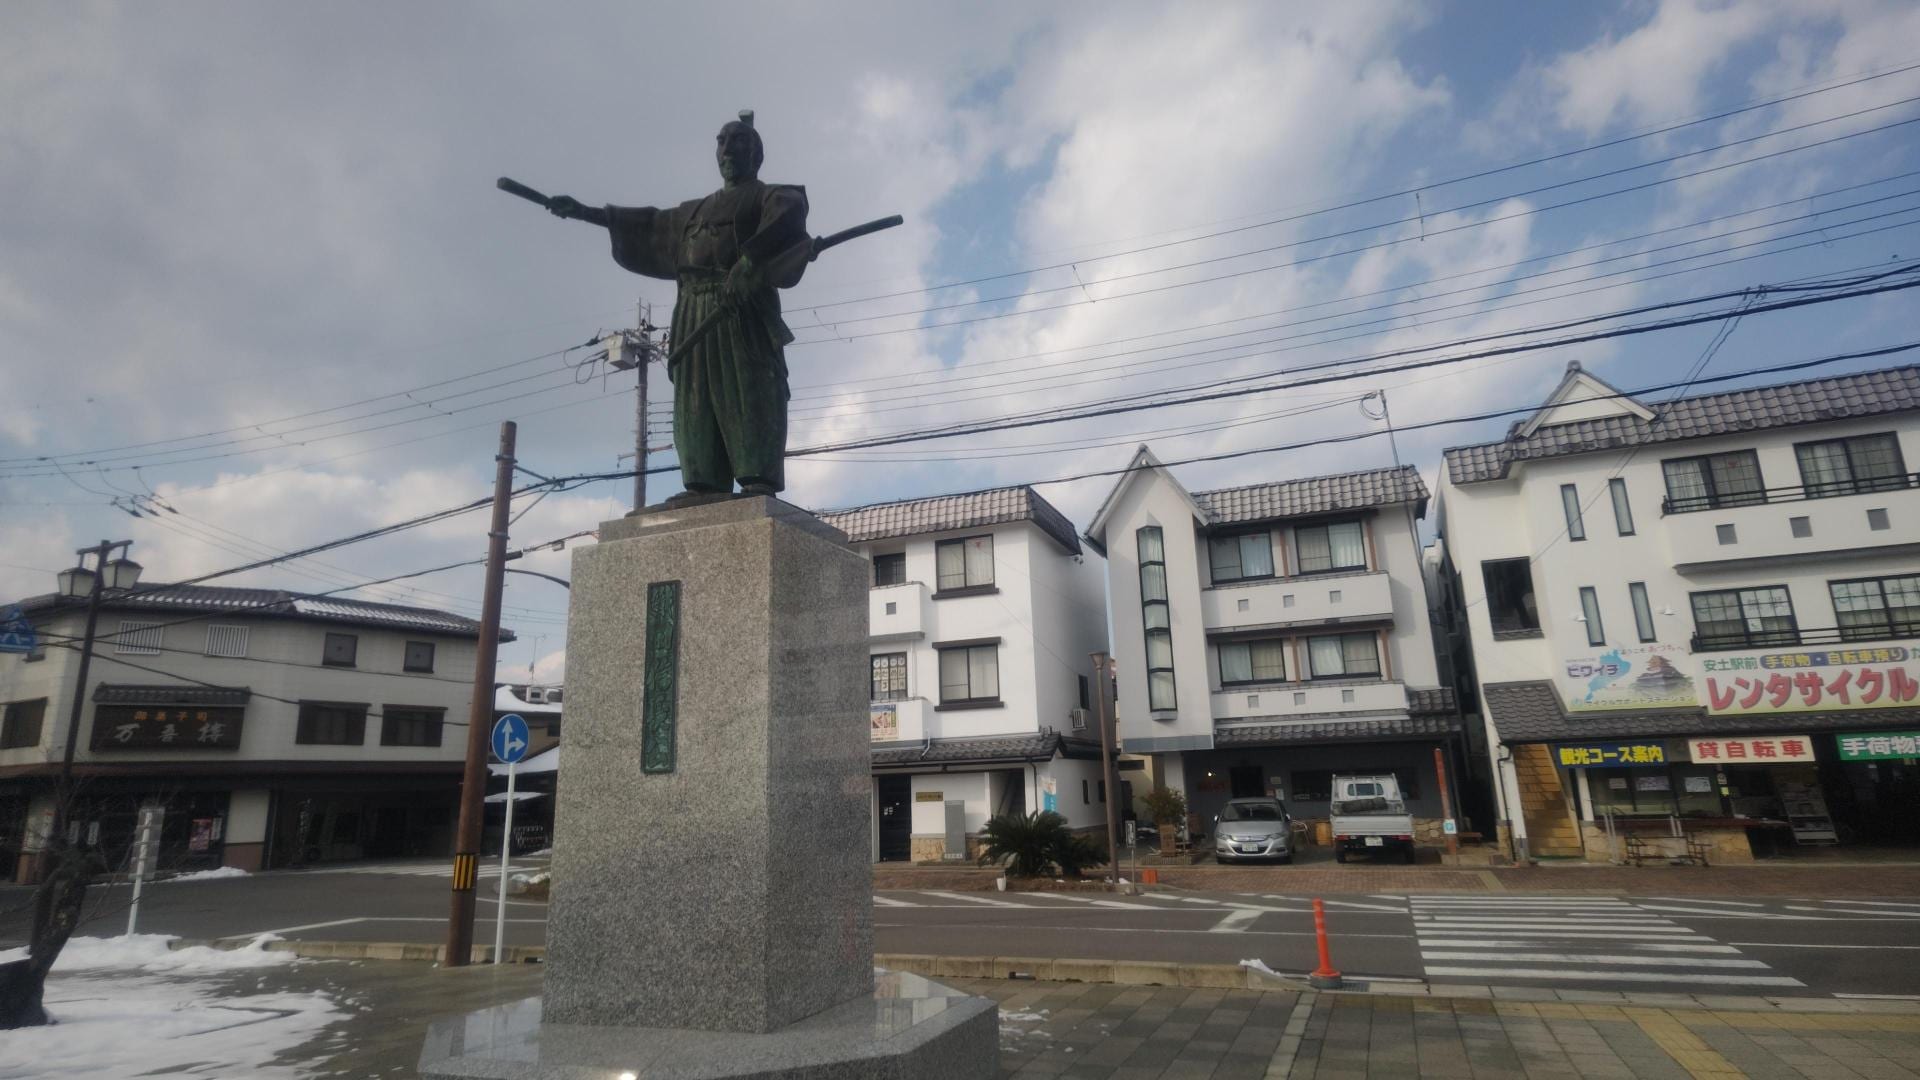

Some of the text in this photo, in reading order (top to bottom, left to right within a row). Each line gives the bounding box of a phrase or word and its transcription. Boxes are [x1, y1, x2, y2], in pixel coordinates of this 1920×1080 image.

[1567, 664, 1619, 678] ビワイチ
[1703, 656, 1759, 671] 安土駅前
[1706, 668, 1918, 710] レンタサイクル
[1560, 746, 1664, 765] 観光コース案内
[1696, 739, 1807, 759] 貸自転車
